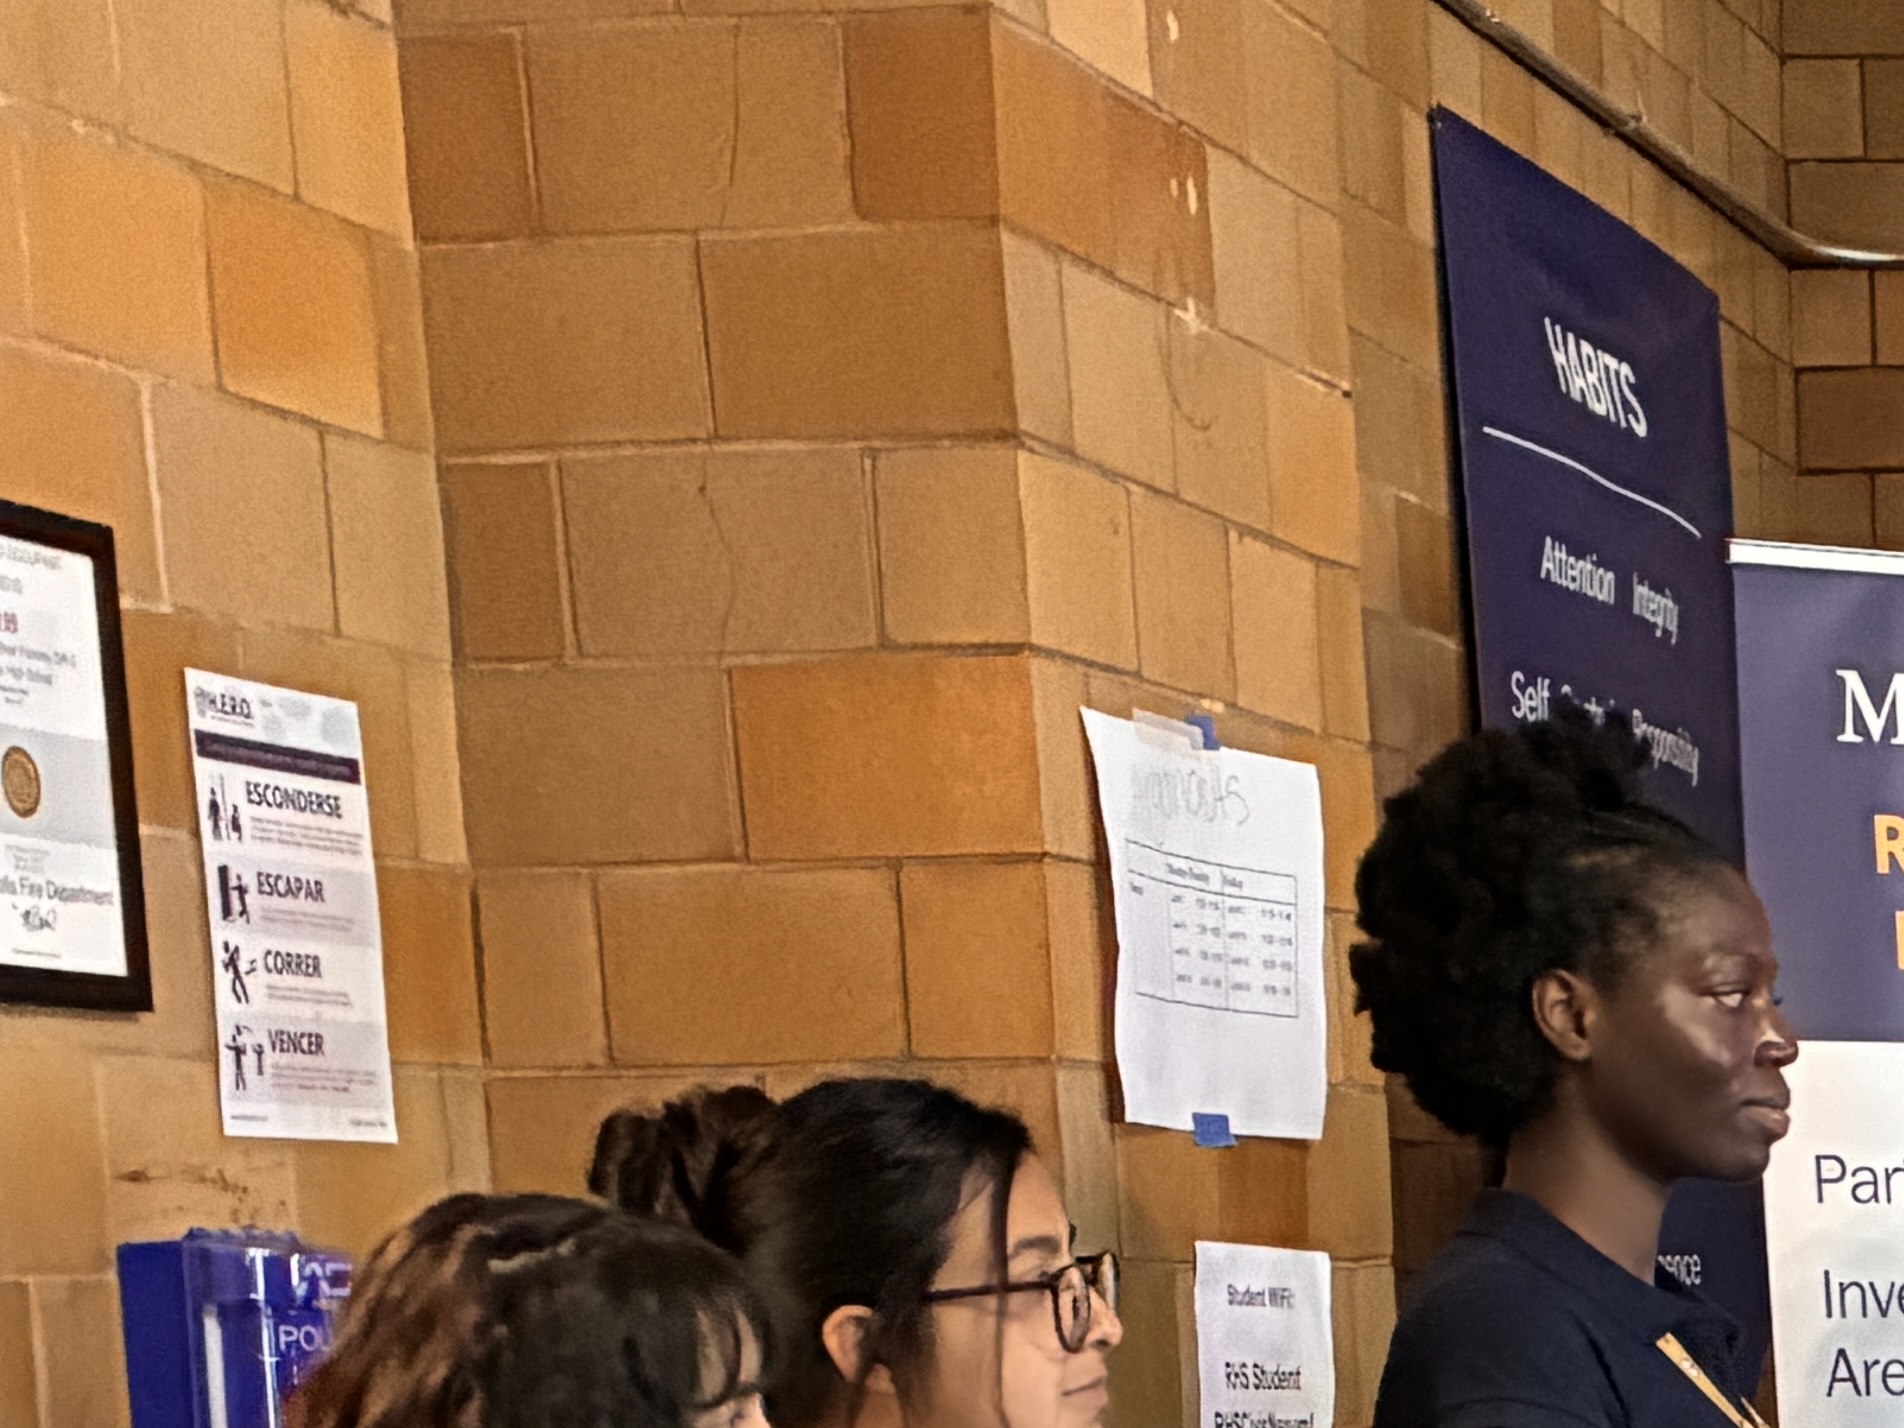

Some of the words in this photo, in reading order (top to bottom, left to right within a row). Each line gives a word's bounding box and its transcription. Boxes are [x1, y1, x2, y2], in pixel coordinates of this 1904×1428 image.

[1543, 315, 1648, 438] HABITS
[1540, 535, 1615, 606] Attention
[1632, 571, 1679, 646] Integrity
[1510, 670, 1551, 723] Self
[245, 780, 343, 820] ESCONDERSE
[256, 870, 327, 903] ESCAPAR
[262, 949, 323, 979] CORRER
[266, 1028, 326, 1058] VENCER
[1252, 1361, 1303, 1391] Student
